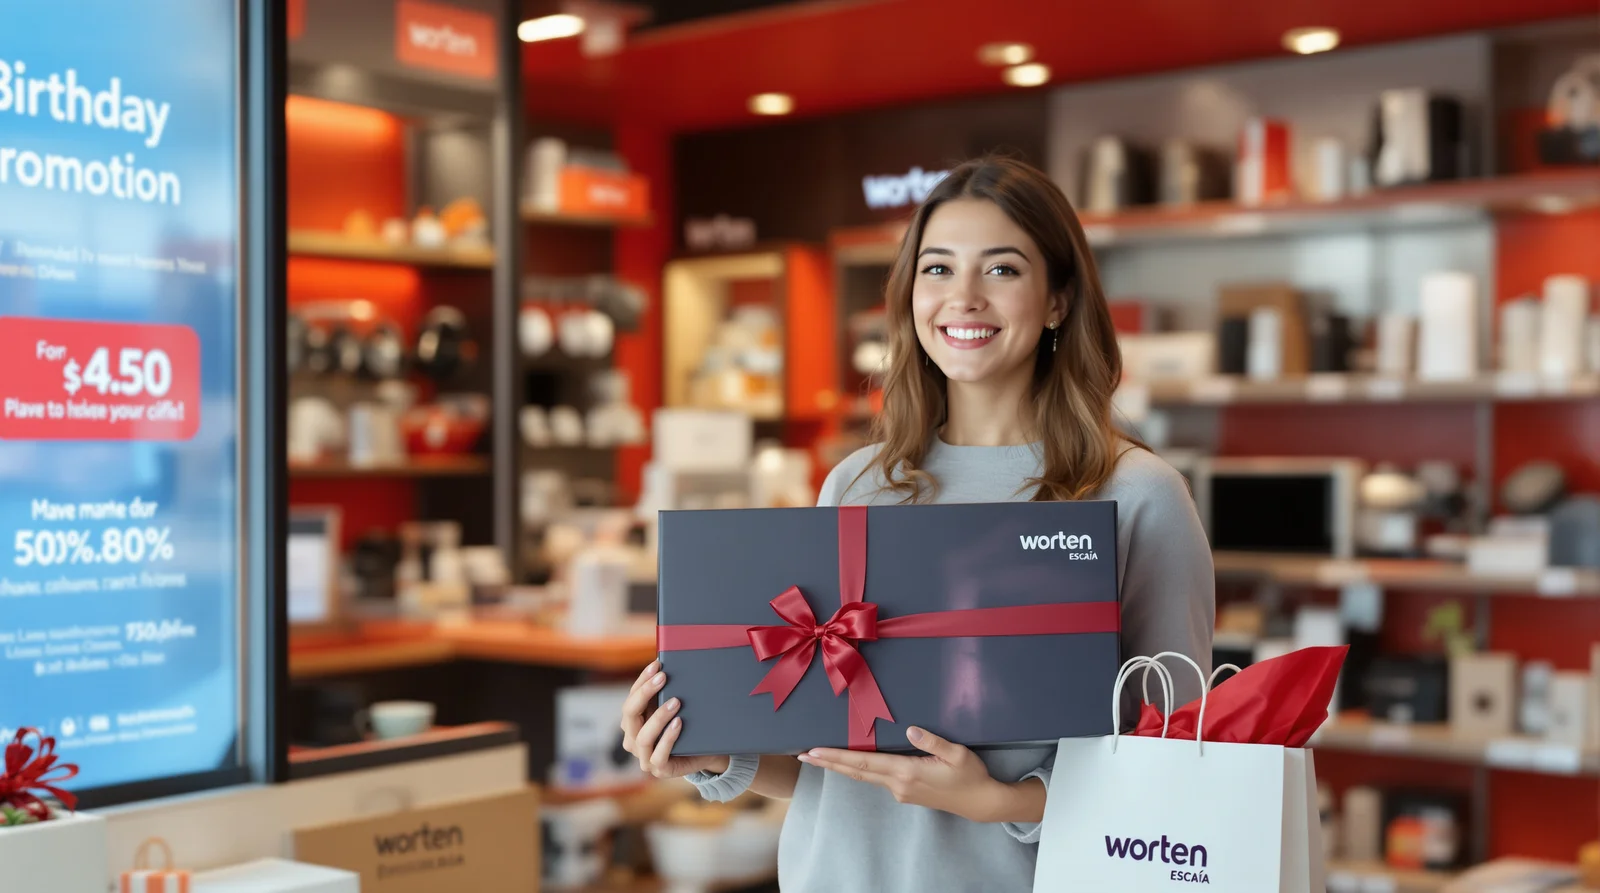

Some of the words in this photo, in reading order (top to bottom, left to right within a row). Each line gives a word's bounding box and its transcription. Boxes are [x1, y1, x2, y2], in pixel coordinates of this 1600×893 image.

[862, 165, 951, 209] worte
[63, 347, 171, 397] $4.50
[47, 400, 64, 419] to
[109, 403, 145, 424] your
[1019, 531, 1092, 550] worten
[373, 821, 464, 857] worten
[1104, 835, 1208, 867] worten
[1170, 870, 1210, 884] ESCAÍA
